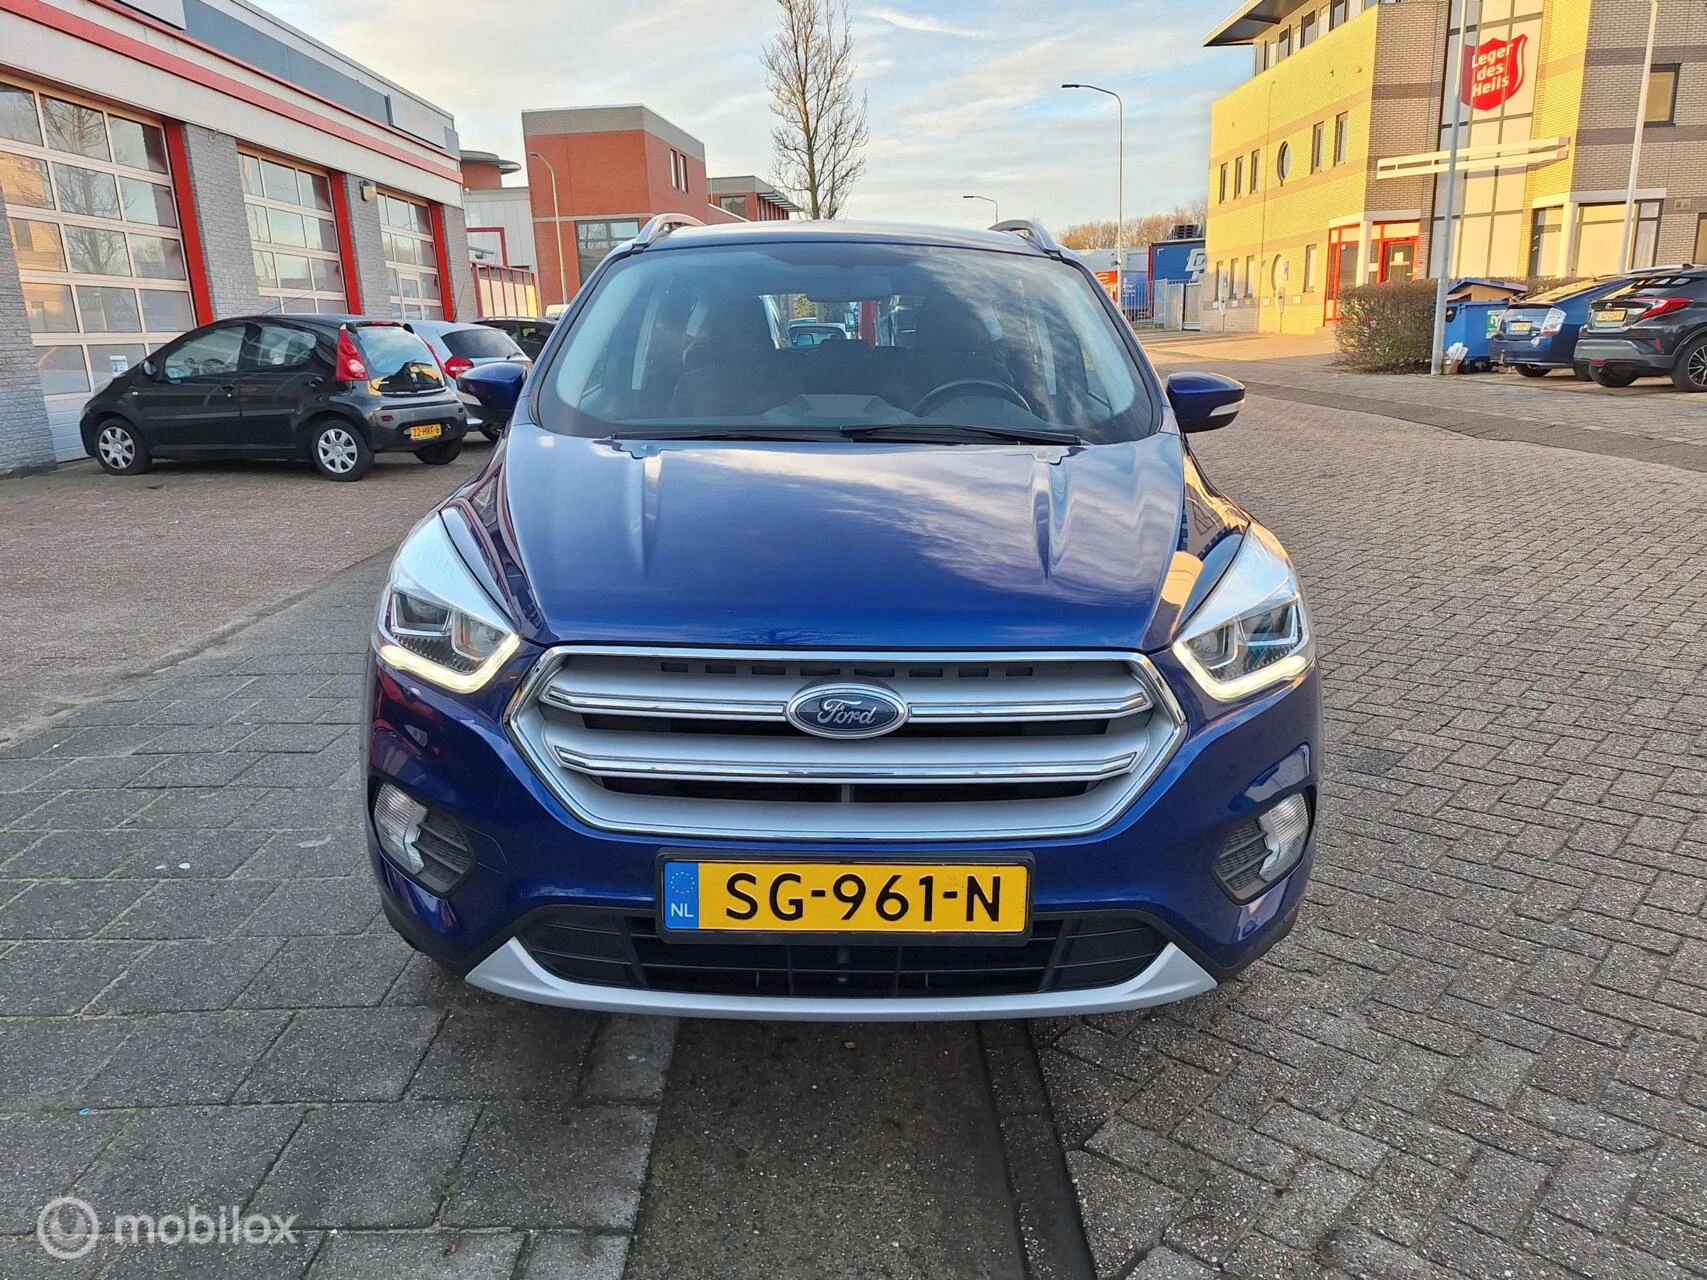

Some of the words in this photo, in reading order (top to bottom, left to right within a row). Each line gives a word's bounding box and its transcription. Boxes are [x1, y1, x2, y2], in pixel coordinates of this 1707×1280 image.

[1472, 43, 1514, 68] Leger
[1477, 63, 1504, 80] des
[1472, 75, 1509, 98] Heils
[817, 699, 877, 724] Ford
[670, 902, 694, 918] NL
[725, 871, 1001, 922] SG-961-N
